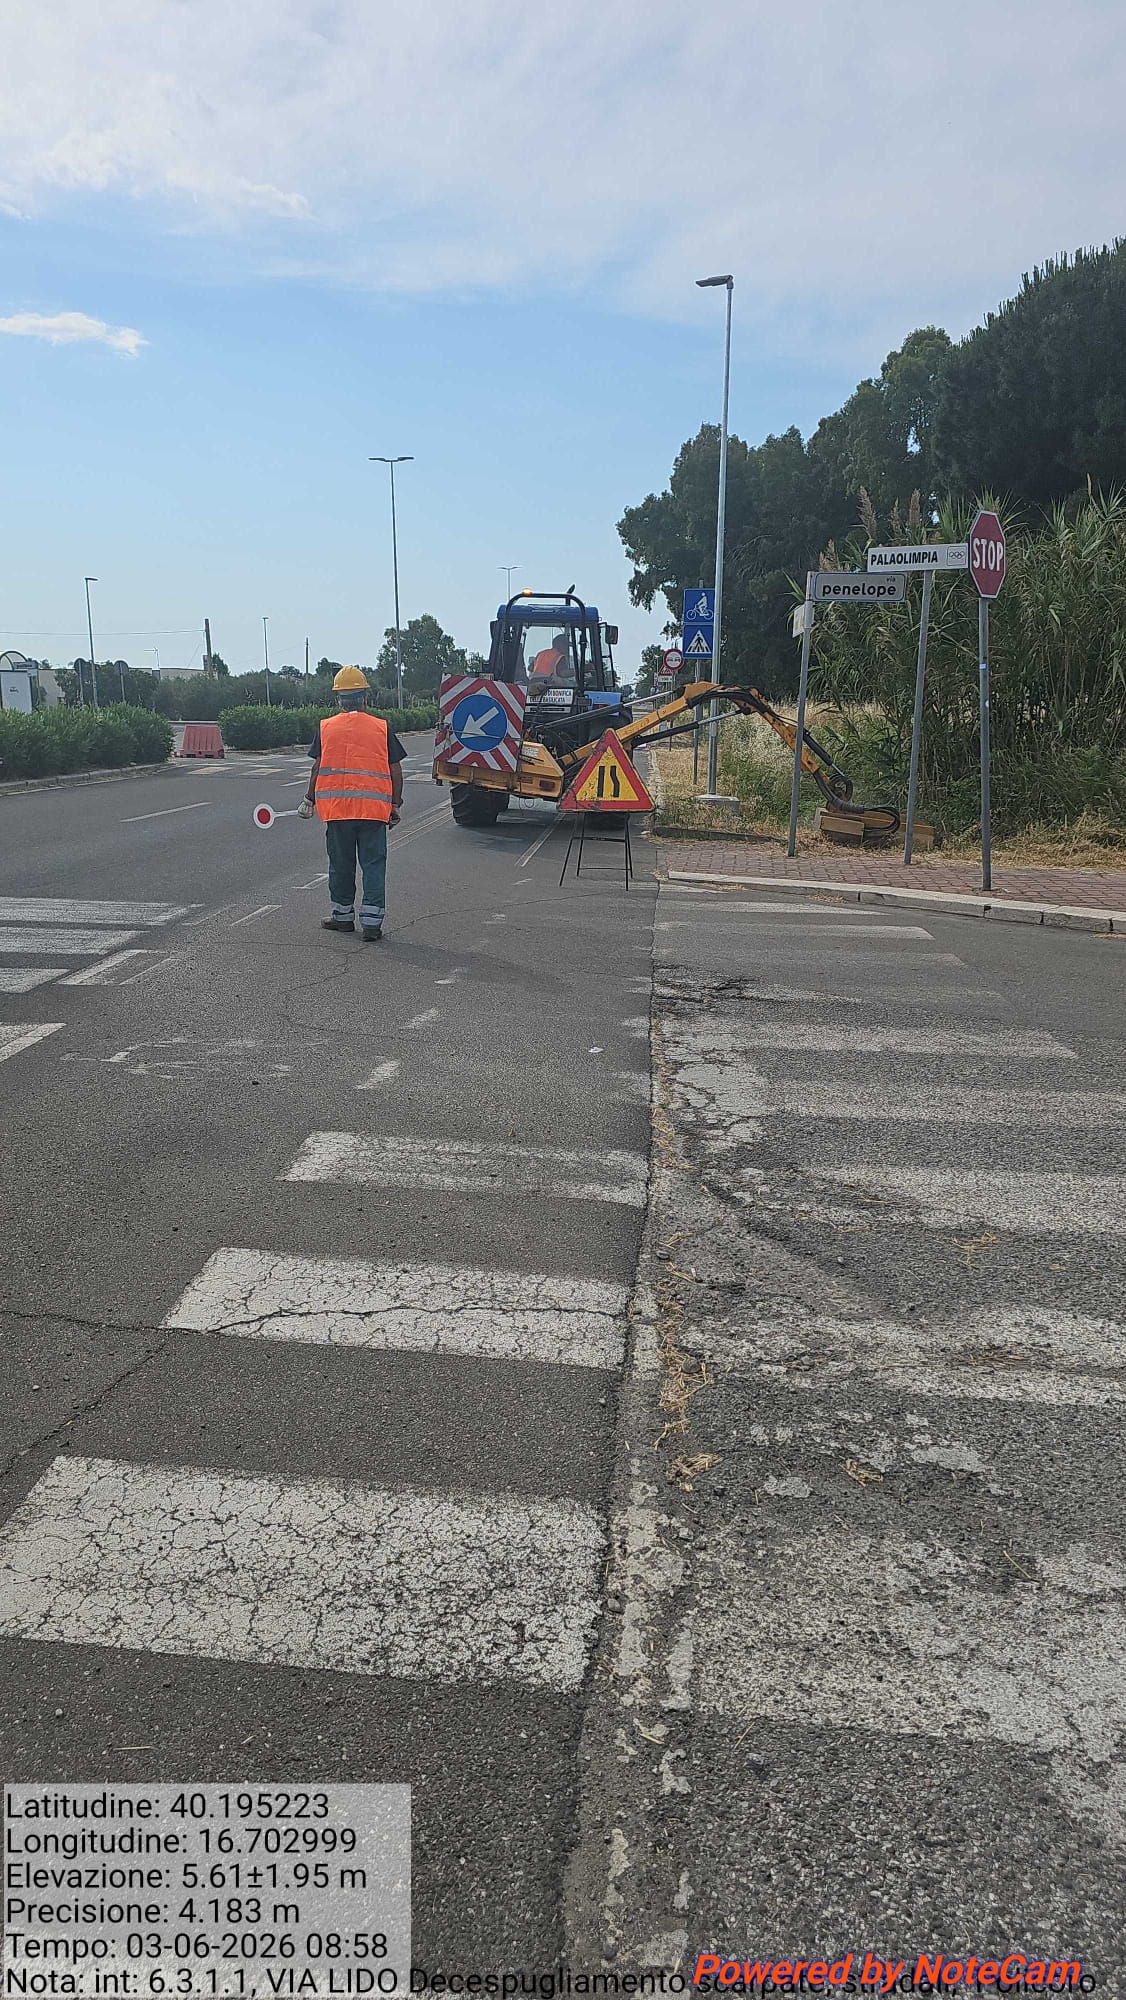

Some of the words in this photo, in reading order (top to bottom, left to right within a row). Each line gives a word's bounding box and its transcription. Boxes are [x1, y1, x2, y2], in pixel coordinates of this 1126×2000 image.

[870, 550, 939, 566] PALAOLIMPIA
[972, 537, 1004, 571] STOP
[886, 575, 896, 583] via
[822, 581, 897, 597] penelope
